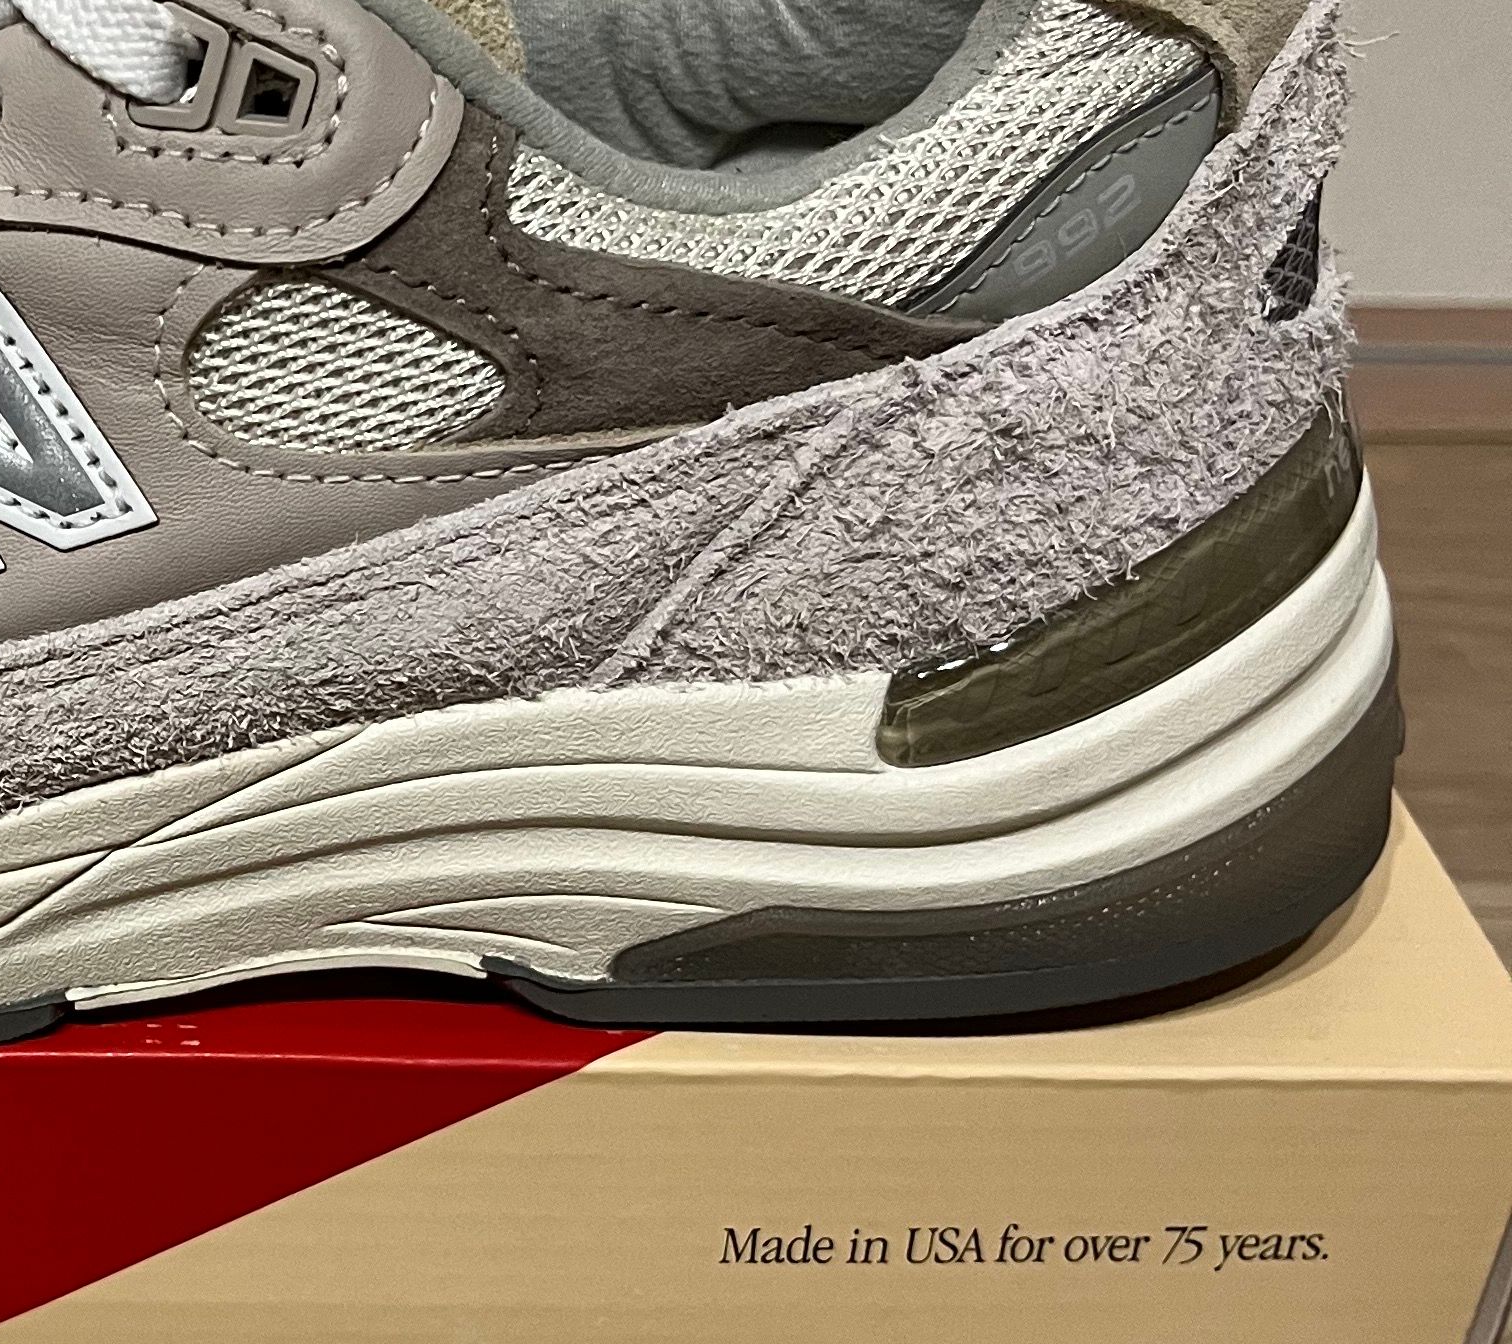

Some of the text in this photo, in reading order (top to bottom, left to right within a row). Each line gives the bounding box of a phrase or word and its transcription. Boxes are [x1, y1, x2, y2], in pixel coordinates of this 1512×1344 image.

[1011, 173, 1142, 285] 992
[718, 1223, 1329, 1272] Made in USA for over 75 years.
